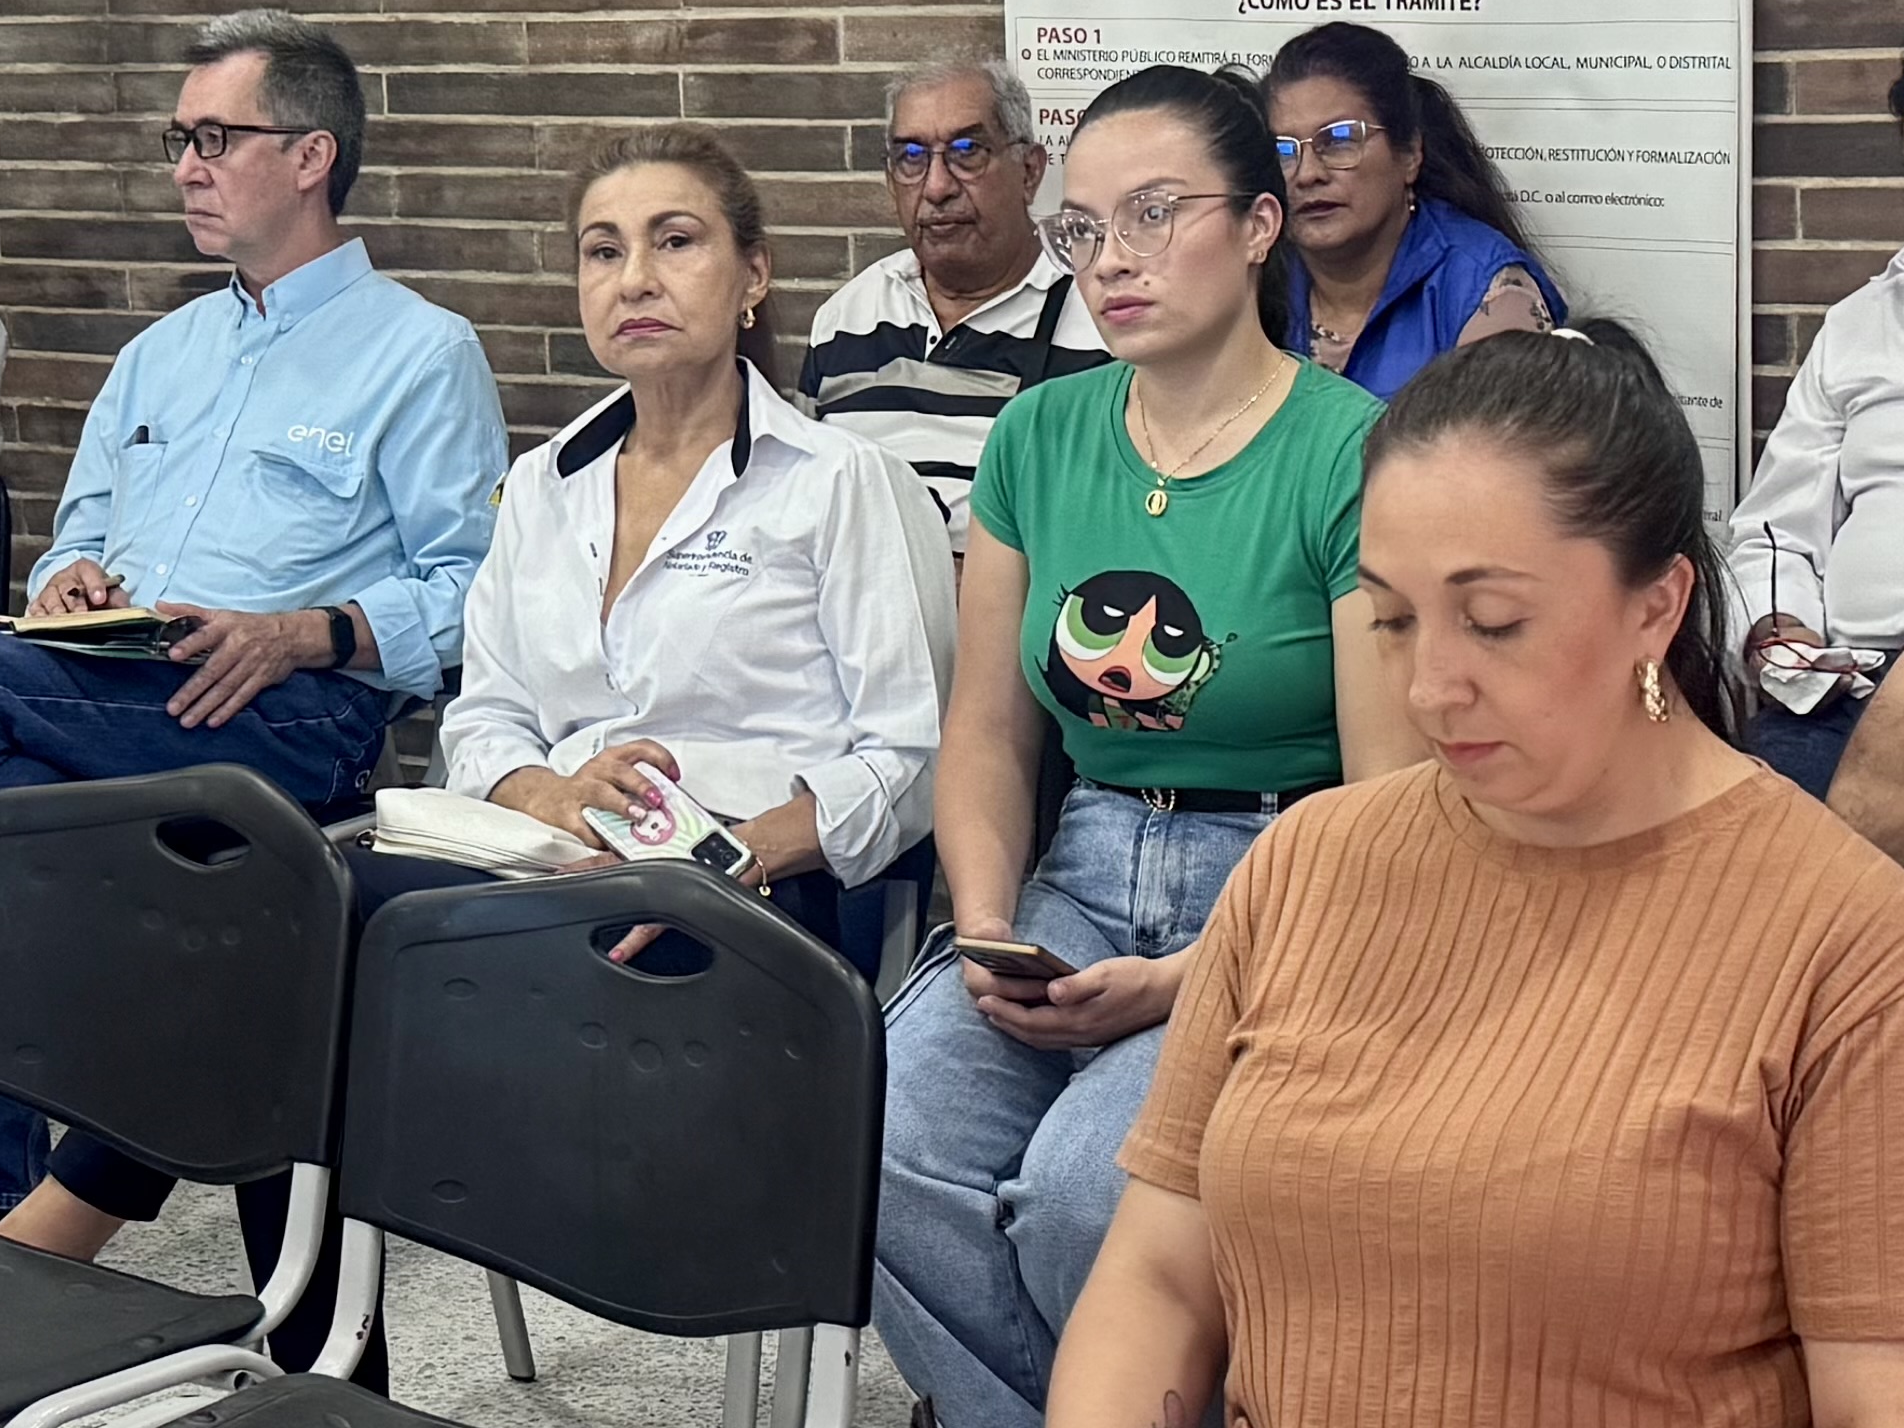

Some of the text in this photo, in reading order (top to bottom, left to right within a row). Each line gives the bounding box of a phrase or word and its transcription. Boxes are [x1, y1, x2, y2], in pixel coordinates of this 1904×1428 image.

[1037, 27, 1101, 45] PASO 1
[1036, 48, 1050, 62] EL
[1052, 49, 1119, 63] MINISTERIO
[1121, 49, 1176, 65] PÚBLICO
[1421, 56, 1431, 69] A
[1436, 56, 1454, 70] LA
[1458, 55, 1523, 70] ALCALDÍA
[1656, 55, 1667, 69] O
[1668, 55, 1731, 70] DISTRITAL
[1036, 66, 1136, 81] CORRESPONDIEN
[1548, 147, 1625, 162] RESTITUCIÓN
[1635, 149, 1731, 165] FORMALIZACIÓN
[287, 424, 355, 458] enel
